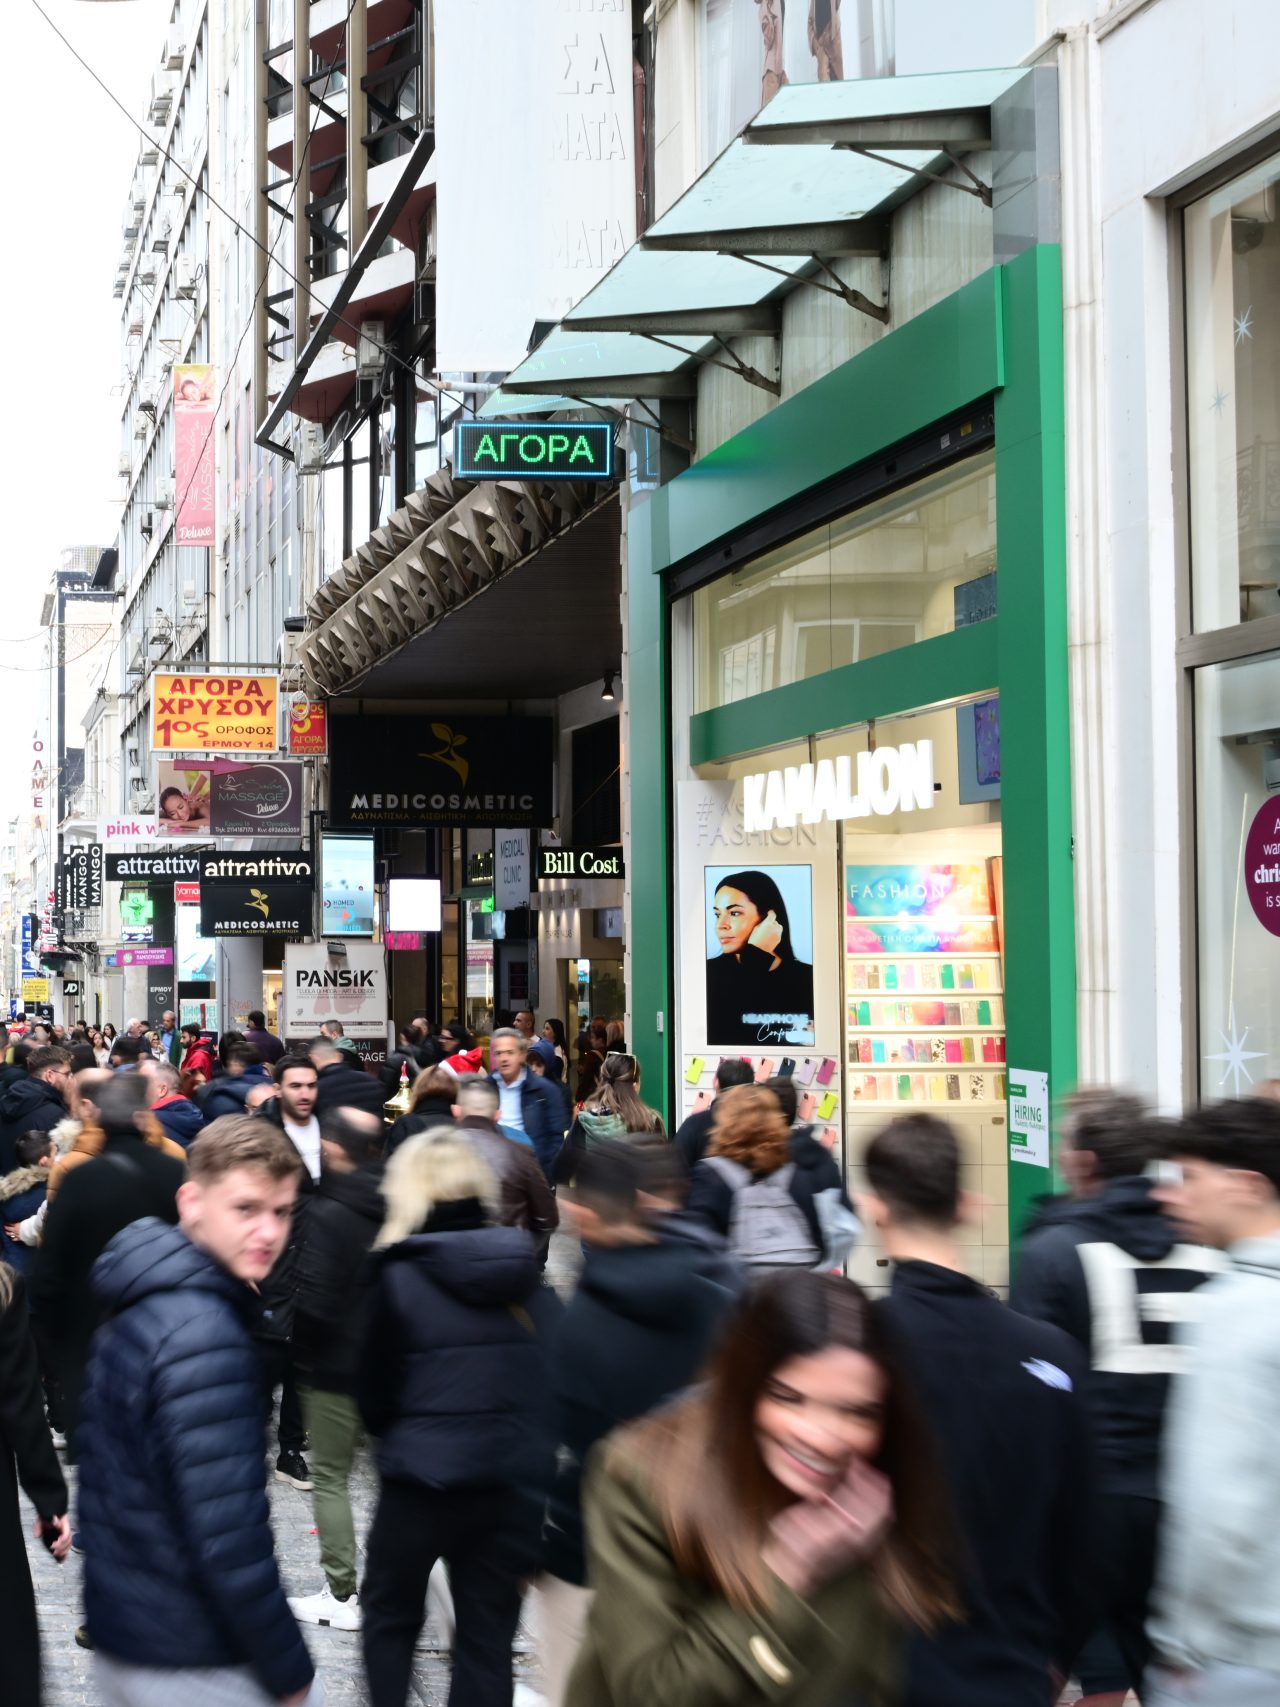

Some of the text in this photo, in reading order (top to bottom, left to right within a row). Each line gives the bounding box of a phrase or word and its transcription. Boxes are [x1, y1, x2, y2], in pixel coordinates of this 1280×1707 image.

[474, 435, 594, 463] ΑΓΟΡΑ
[201, 428, 211, 511] MASSAGE
[180, 525, 212, 540] Deluxe
[170, 679, 263, 697] ΑΓΟΡΑ
[157, 698, 273, 716] ΧΡΥΣΟΥ
[216, 726, 274, 735] ΟΡΟΦΟΣ
[203, 740, 273, 749] ΕΡΜΟΥ 14
[743, 739, 934, 833] KAMALION
[218, 793, 284, 801] MASSAGE
[350, 794, 534, 810] MEDICOSMETIC
[257, 803, 279, 815] Deluxe
[107, 821, 140, 837] pink
[501, 837, 524, 858] MEDICAL
[205, 857, 310, 876] attrattivo
[544, 852, 619, 874] Bill Cost
[79, 856, 87, 906] MANGO
[91, 846, 101, 903] MANGO
[504, 864, 522, 883] CLINIC
[850, 884, 944, 899] FASHION
[214, 921, 299, 929] MEDICOSMETIC
[65, 983, 78, 993] JD
[1014, 1104, 1042, 1122] HIRING
